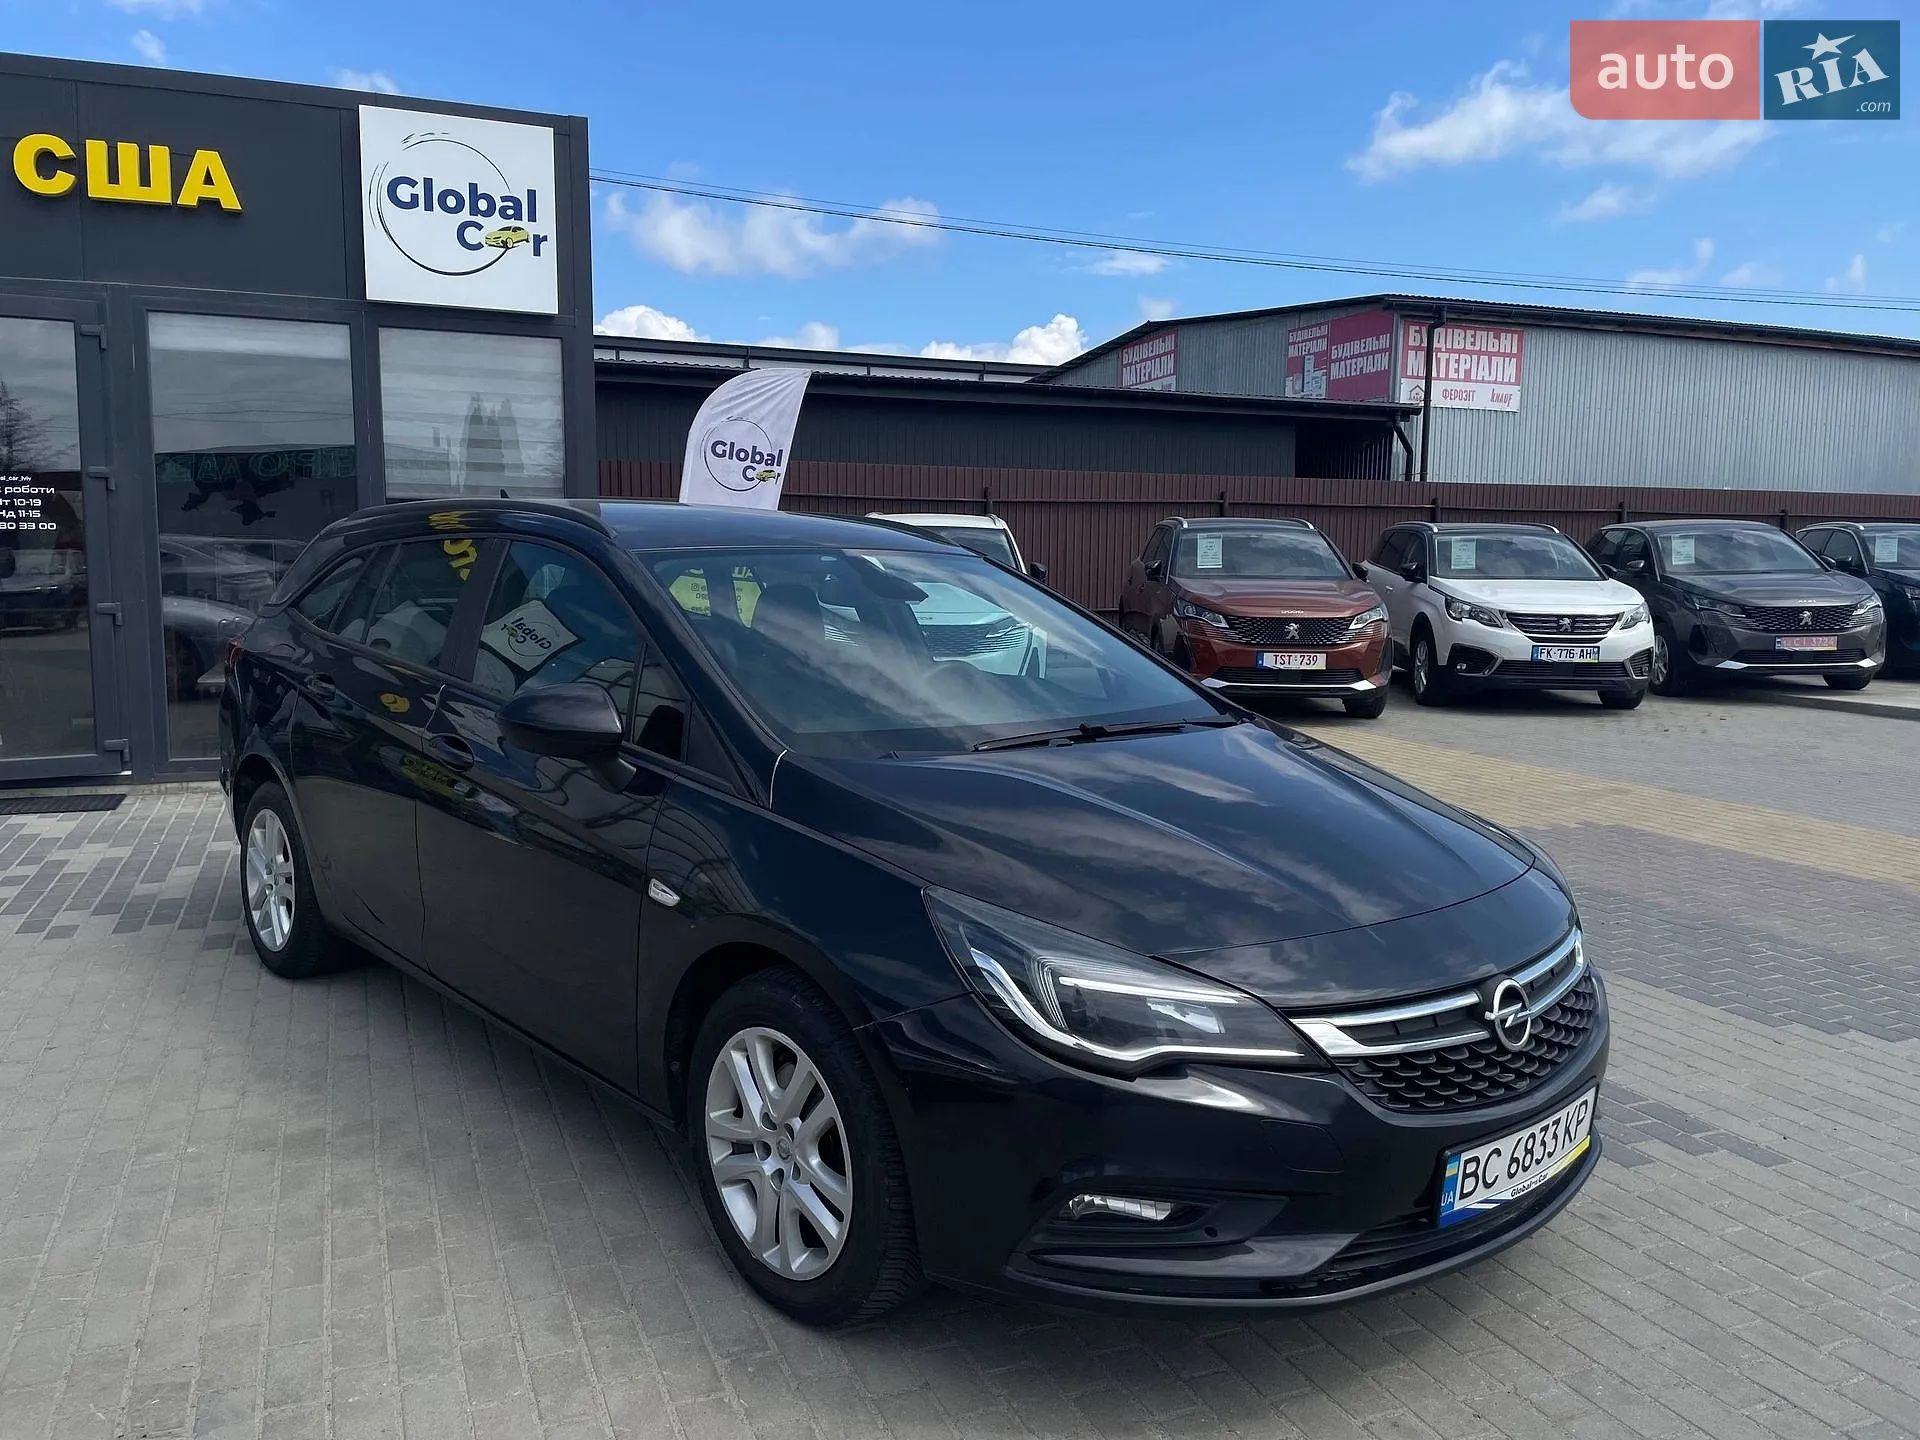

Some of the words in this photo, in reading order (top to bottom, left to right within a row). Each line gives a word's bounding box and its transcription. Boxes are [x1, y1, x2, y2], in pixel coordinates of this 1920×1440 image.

[13, 133, 242, 213] США
[387, 176, 537, 223] Global
[1122, 333, 1175, 365] БУДІВЕЛЬНІ
[1331, 333, 1390, 360] БУДІВЕЛЬНІ
[1122, 353, 1175, 387] МАТЕРІАЛИ
[1330, 352, 1389, 380] МАТЕРІАЛИ
[710, 440, 784, 467] Global
[4, 484, 55, 495] роботи
[13, 498, 42, 507] 10-19
[18, 509, 41, 518] 11-15
[18, 521, 36, 530] 33
[38, 522, 57, 530] 00
[1459, 1147, 1502, 1201] BC
[1507, 1116, 1562, 1179] 6833
[1561, 1098, 1588, 1150] KP
[1440, 1190, 1454, 1206] UA
